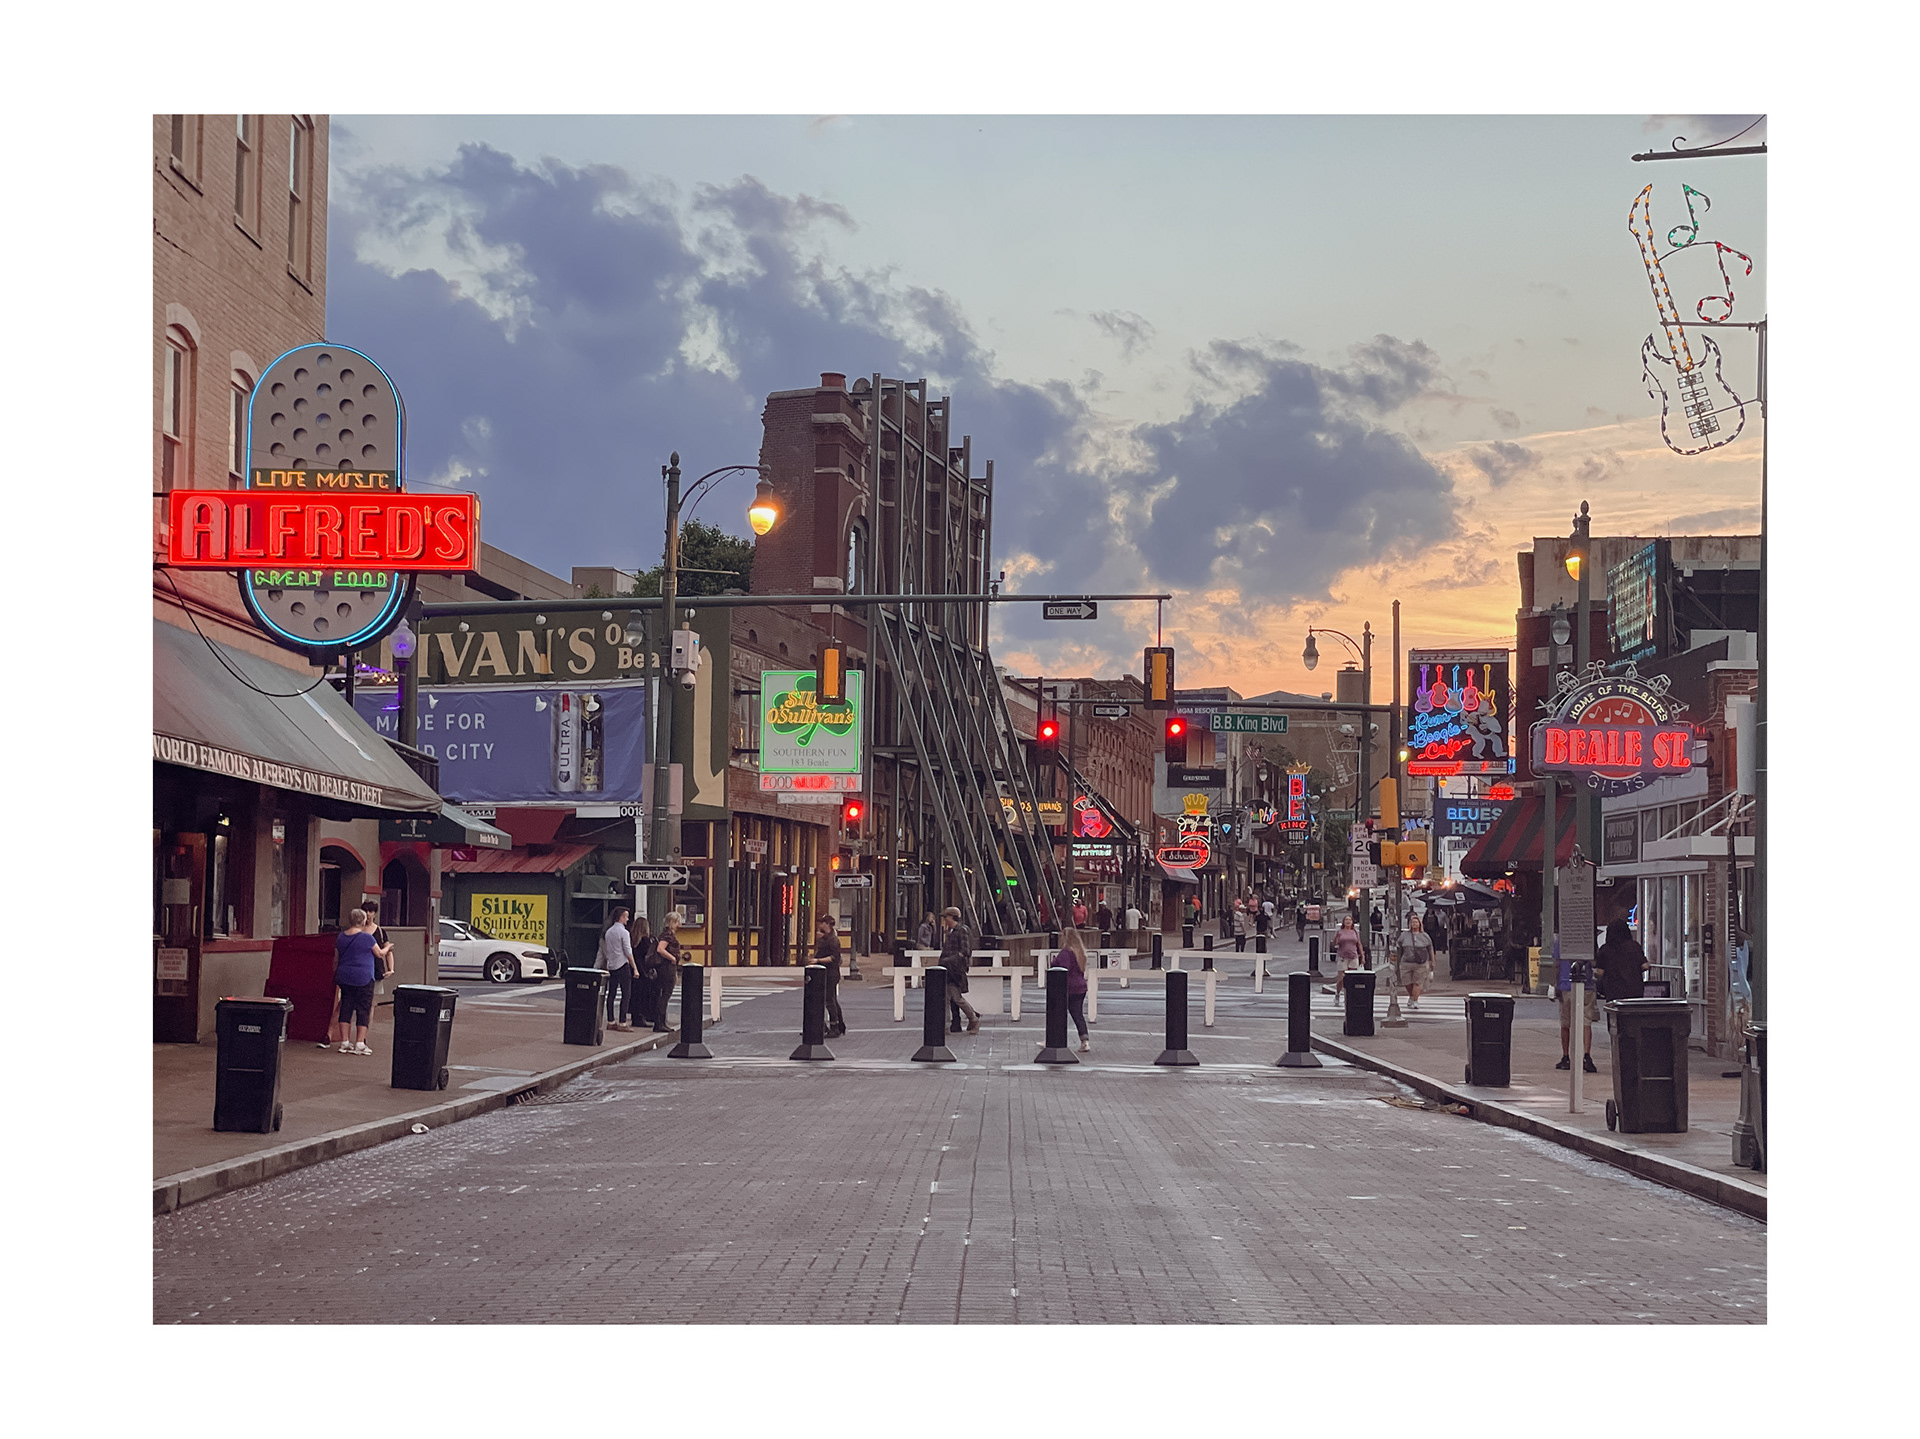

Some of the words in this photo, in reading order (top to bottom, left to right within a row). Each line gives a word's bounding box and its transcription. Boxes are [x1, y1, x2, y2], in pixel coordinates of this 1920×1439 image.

[256, 470, 307, 488] LIVE
[316, 471, 390, 490] MUSIC
[181, 495, 466, 561] ALFRED'S
[254, 570, 322, 587] GREAT
[333, 571, 388, 588] FOOD
[784, 690, 818, 709] SIL
[1569, 692, 1596, 720] HOME
[1597, 684, 1613, 696] OF
[1617, 684, 1639, 696] THE
[1638, 691, 1668, 722] BLUES
[446, 713, 486, 730] FOR
[766, 704, 855, 724] O'Sullivan's
[1414, 712, 1452, 731] Rum
[1236, 716, 1258, 732] King
[1261, 716, 1286, 732] Blvd.
[560, 718, 571, 767] ULTRA
[1413, 722, 1461, 748] Boogie
[446, 743, 495, 760] CITY
[772, 748, 825, 757] SOUTHERN
[827, 748, 847, 757] FUN
[1425, 738, 1463, 759] Cafe
[1544, 728, 1643, 767] BEALE
[1652, 731, 1692, 768] ST.
[790, 758, 805, 767] 183
[807, 758, 829, 767] Beale
[200, 745, 251, 779] FAMOUS
[252, 759, 302, 790] ALFRED'S
[303, 771, 318, 793] ON
[320, 775, 349, 798] BEALE
[350, 782, 383, 806] STREET
[1587, 774, 1646, 794] GIFTS
[1446, 807, 1503, 821] BLUES
[1280, 820, 1308, 830] KING
[1168, 850, 1199, 860] Schwab
[632, 871, 649, 880] ONE
[651, 871, 669, 880] WAY
[481, 897, 535, 920] Silky
[498, 932, 545, 940] OYSTERS
